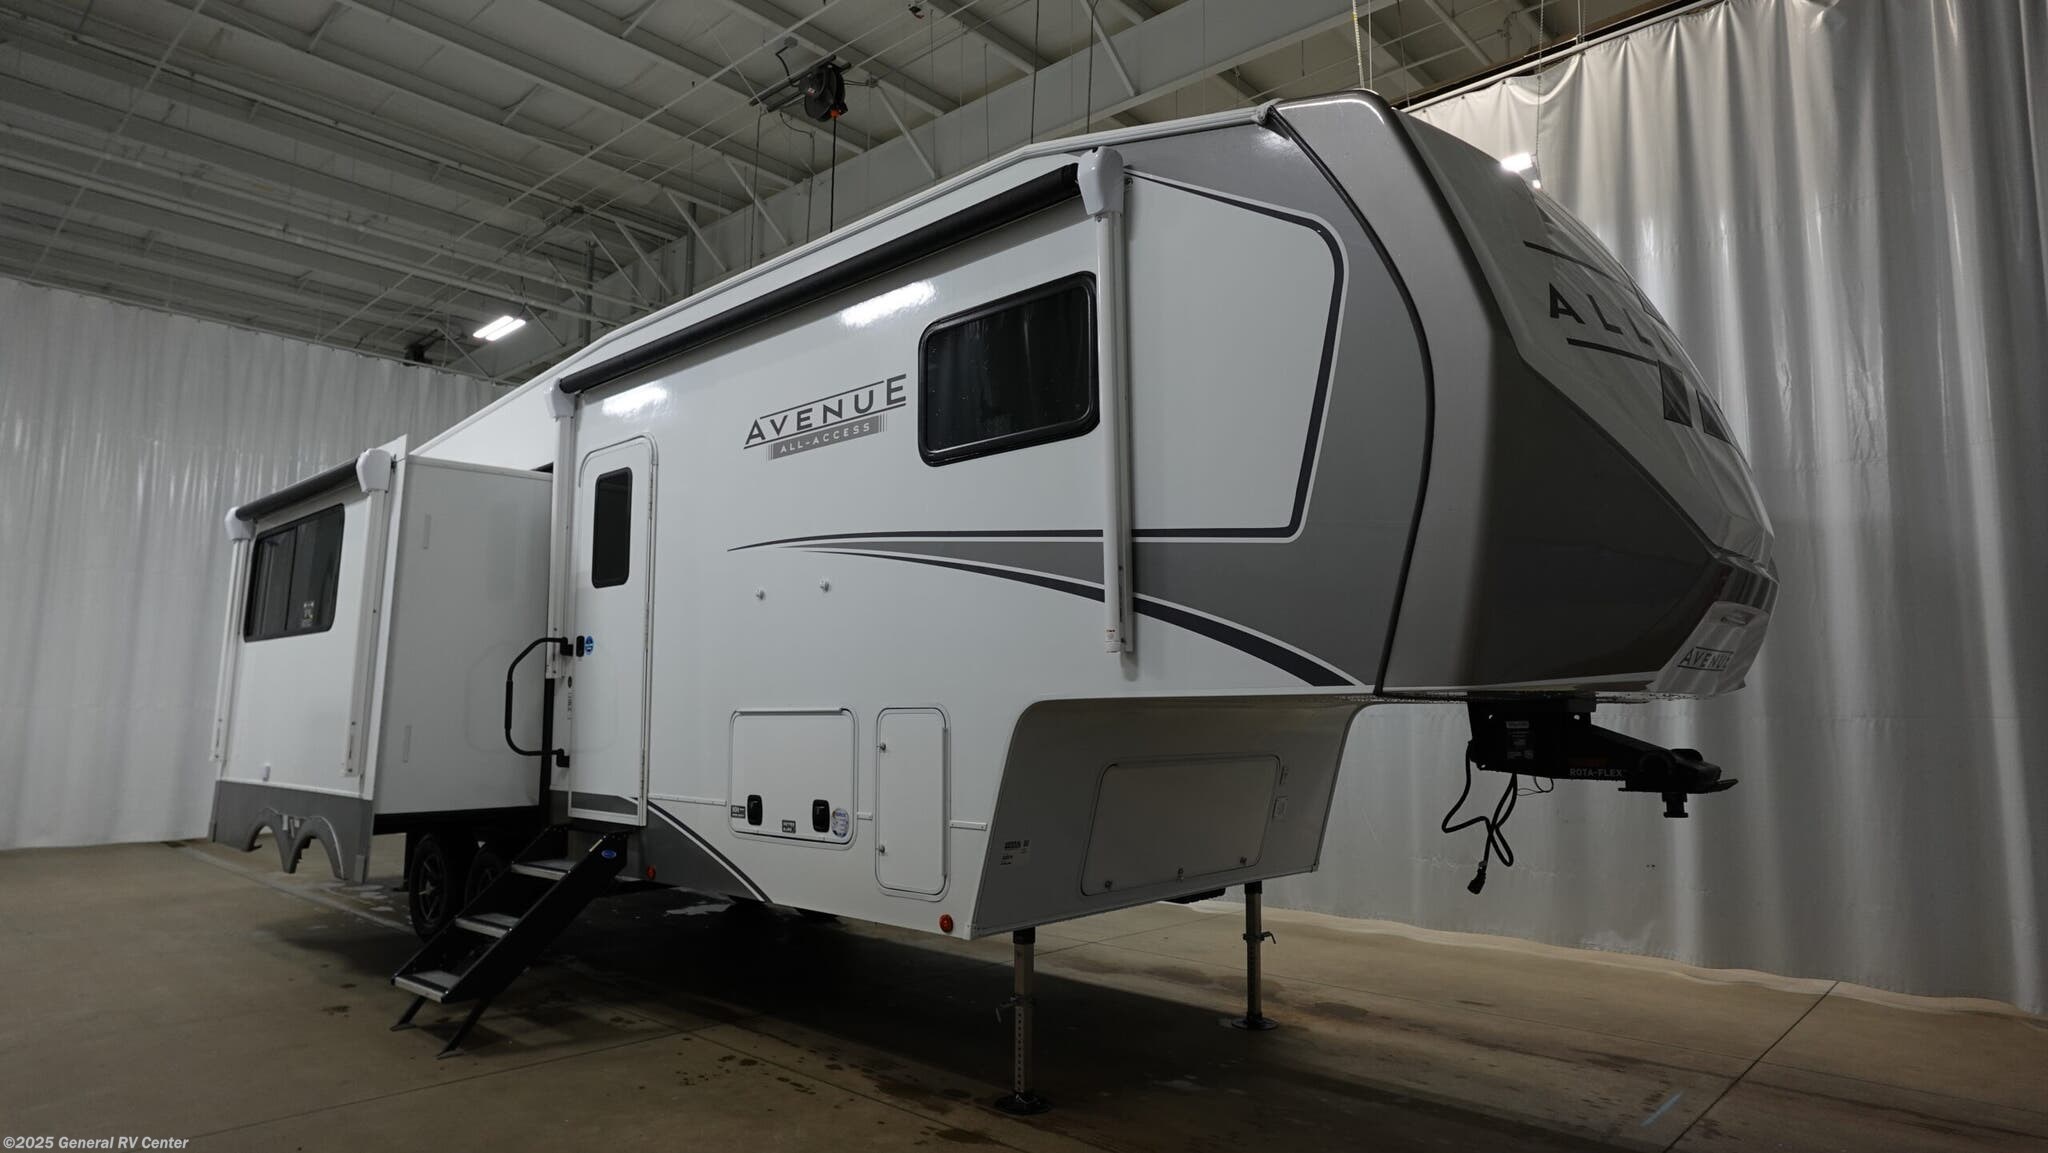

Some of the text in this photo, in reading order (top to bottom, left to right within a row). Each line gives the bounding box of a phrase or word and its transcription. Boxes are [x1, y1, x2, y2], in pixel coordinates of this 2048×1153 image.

[745, 373, 907, 446] AVENUE
[780, 422, 871, 455] ALL-ACCESS
[1569, 768, 1623, 777] ROTA-FLEX
